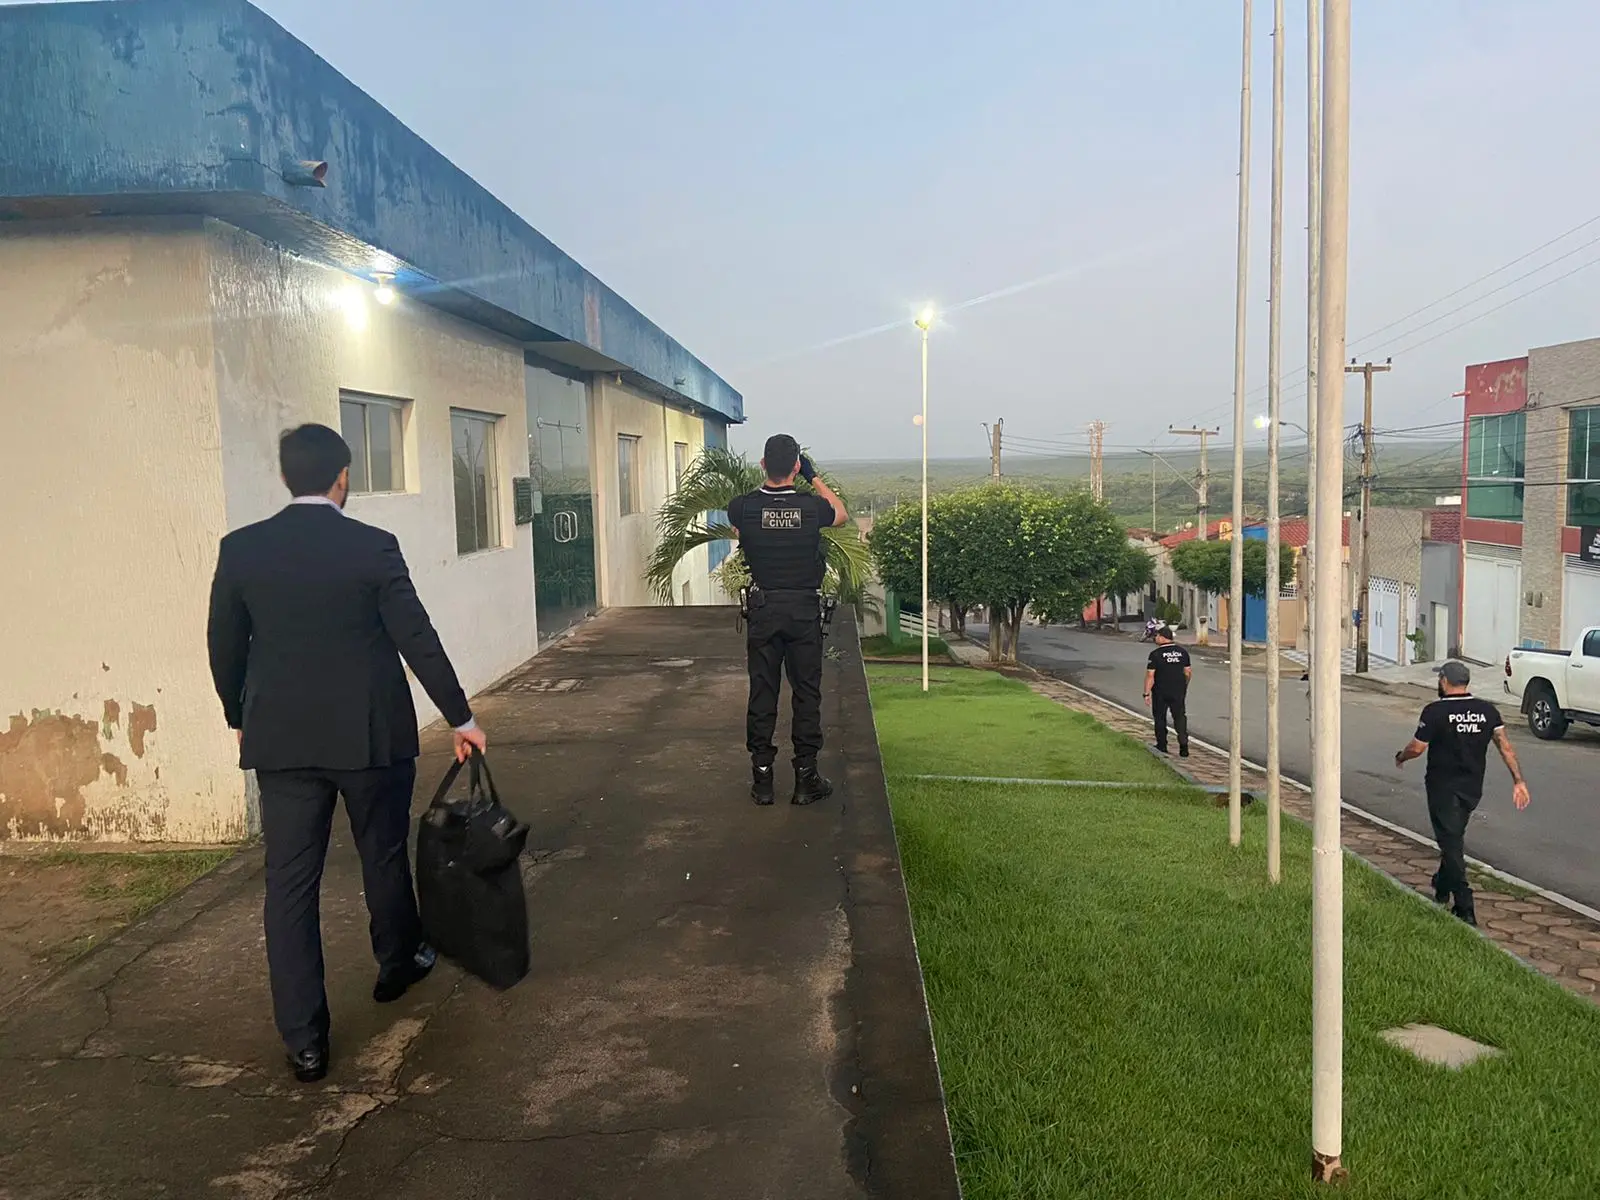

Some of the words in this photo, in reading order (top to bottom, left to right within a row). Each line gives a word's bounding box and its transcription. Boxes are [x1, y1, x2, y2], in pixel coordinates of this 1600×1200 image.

[769, 519, 794, 527] CIVIL
[1448, 710, 1486, 723] POLÍCIA
[1456, 723, 1481, 733] CIVIL
